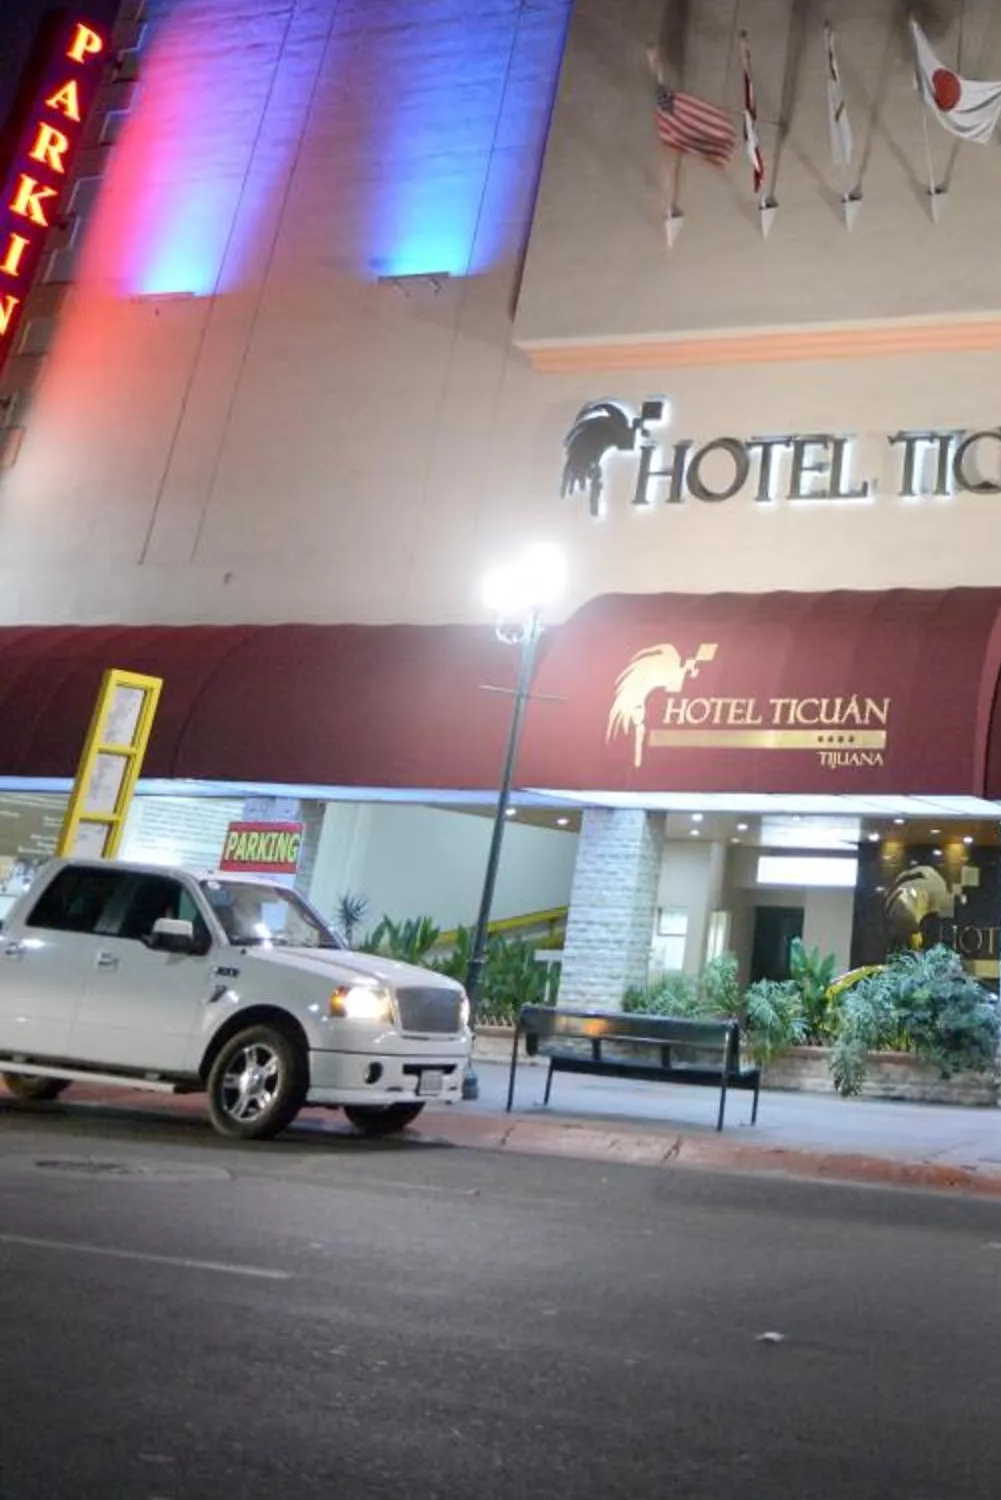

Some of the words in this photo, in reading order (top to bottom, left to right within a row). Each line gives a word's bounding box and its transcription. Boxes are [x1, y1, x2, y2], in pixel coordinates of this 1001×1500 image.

[631, 434, 870, 504] HOTEL
[662, 697, 763, 725] HOTEL
[769, 693, 891, 725] TICUÁN
[816, 751, 884, 769] TIJUANA
[225, 830, 301, 861] PARKING
